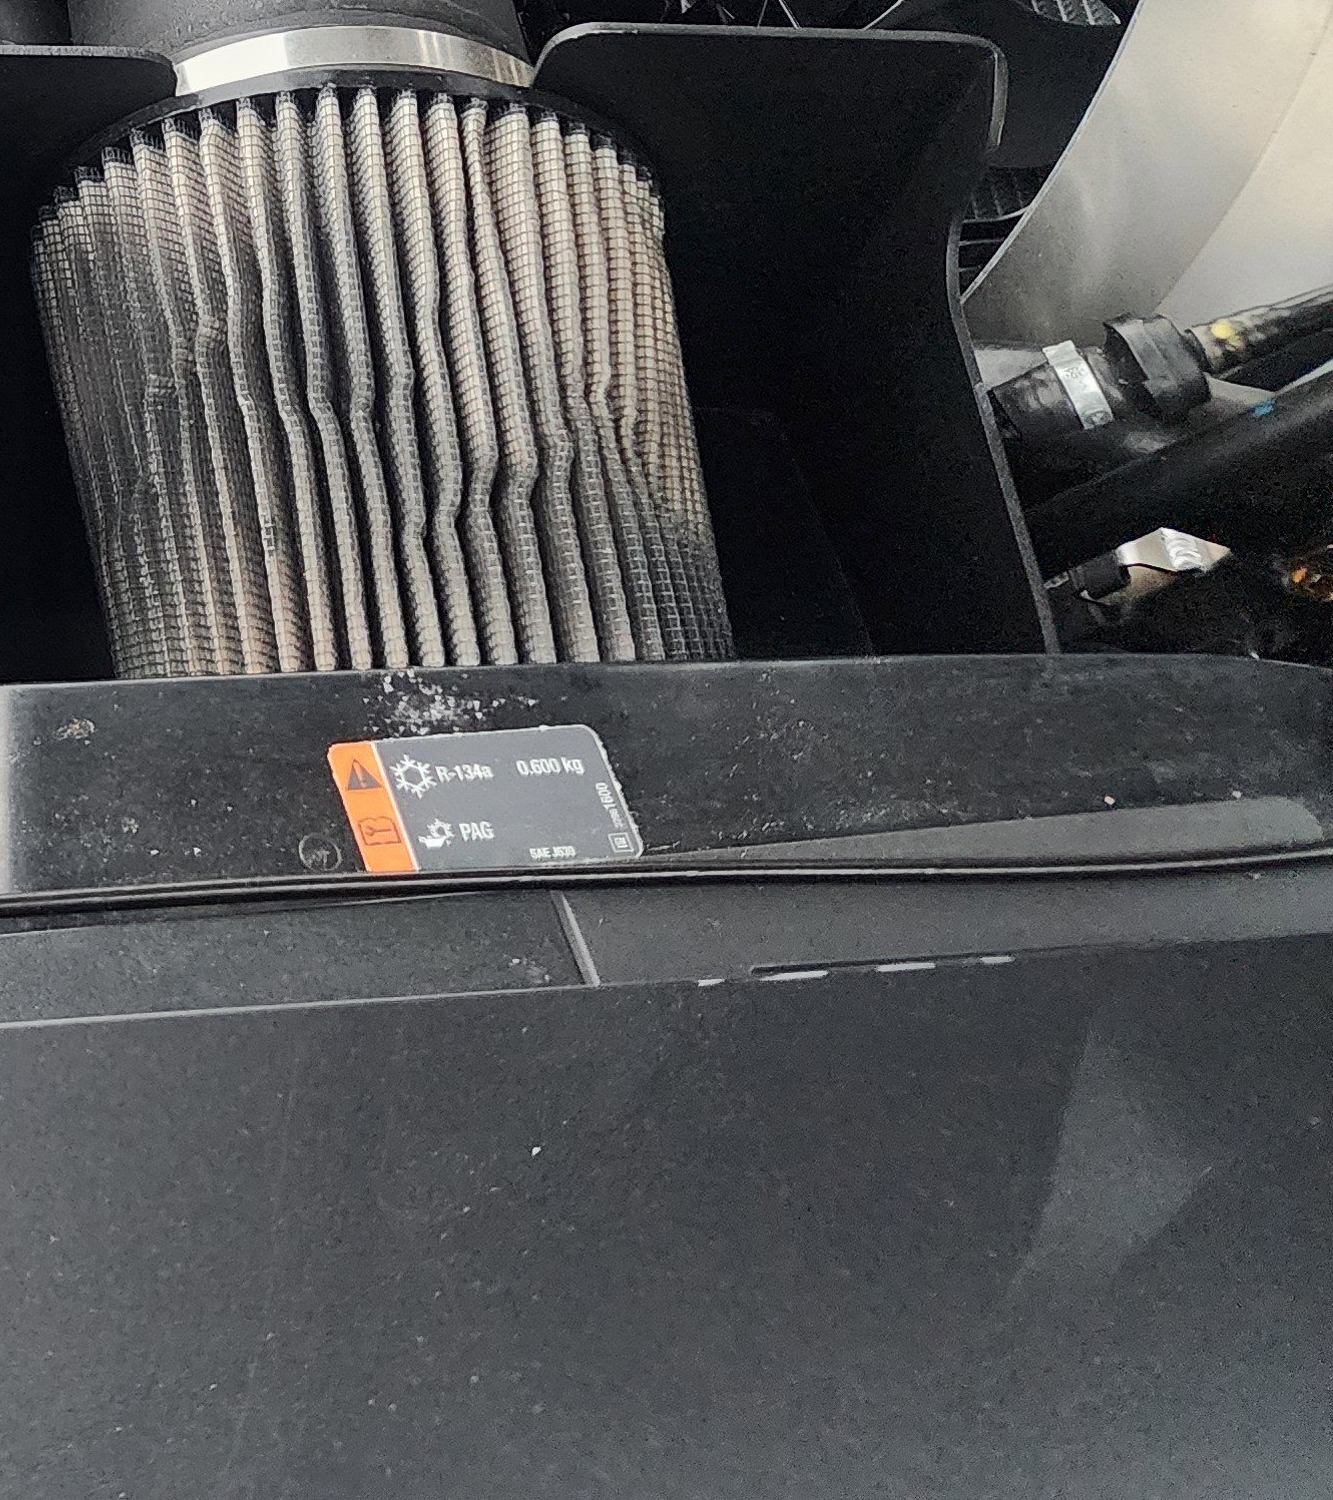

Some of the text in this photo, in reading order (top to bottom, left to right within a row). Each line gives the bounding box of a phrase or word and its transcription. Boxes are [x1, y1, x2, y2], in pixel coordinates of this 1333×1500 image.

[435, 756, 585, 783] R-134a 0.600 kg
[458, 820, 495, 842] PAG
